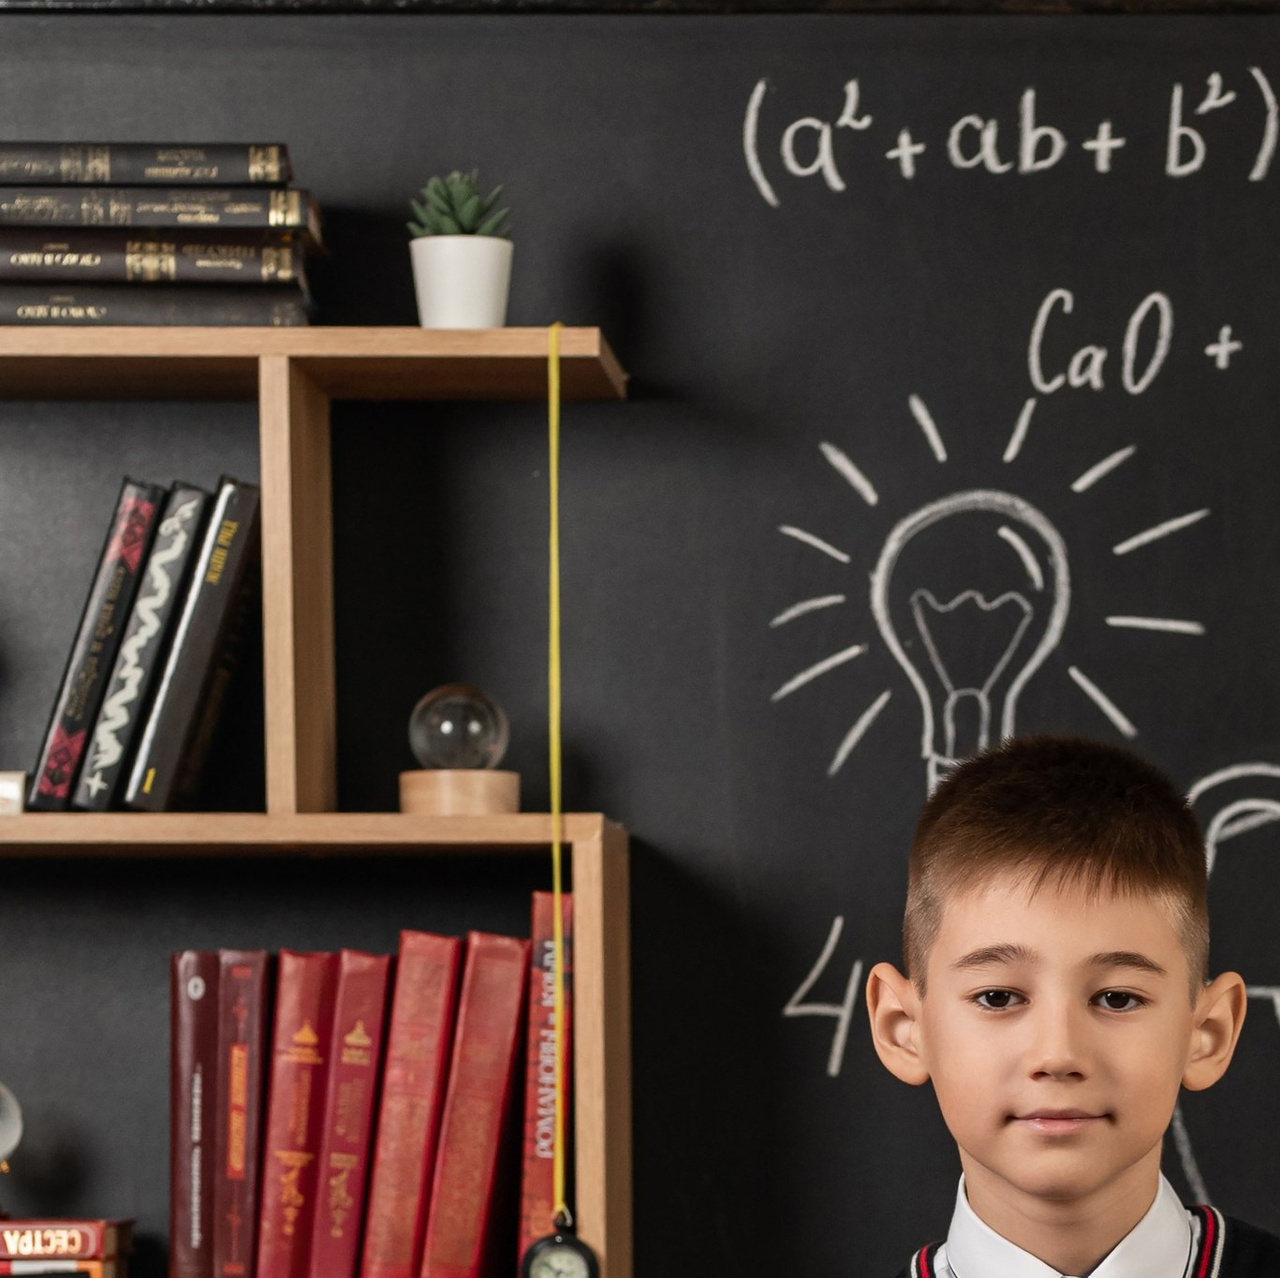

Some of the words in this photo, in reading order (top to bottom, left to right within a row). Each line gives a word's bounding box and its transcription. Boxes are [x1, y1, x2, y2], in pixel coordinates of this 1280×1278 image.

[1028, 289, 1173, 394] CaO
[784, 916, 863, 1076] 4
[3, 1229, 82, 1256] СЕСТРА
